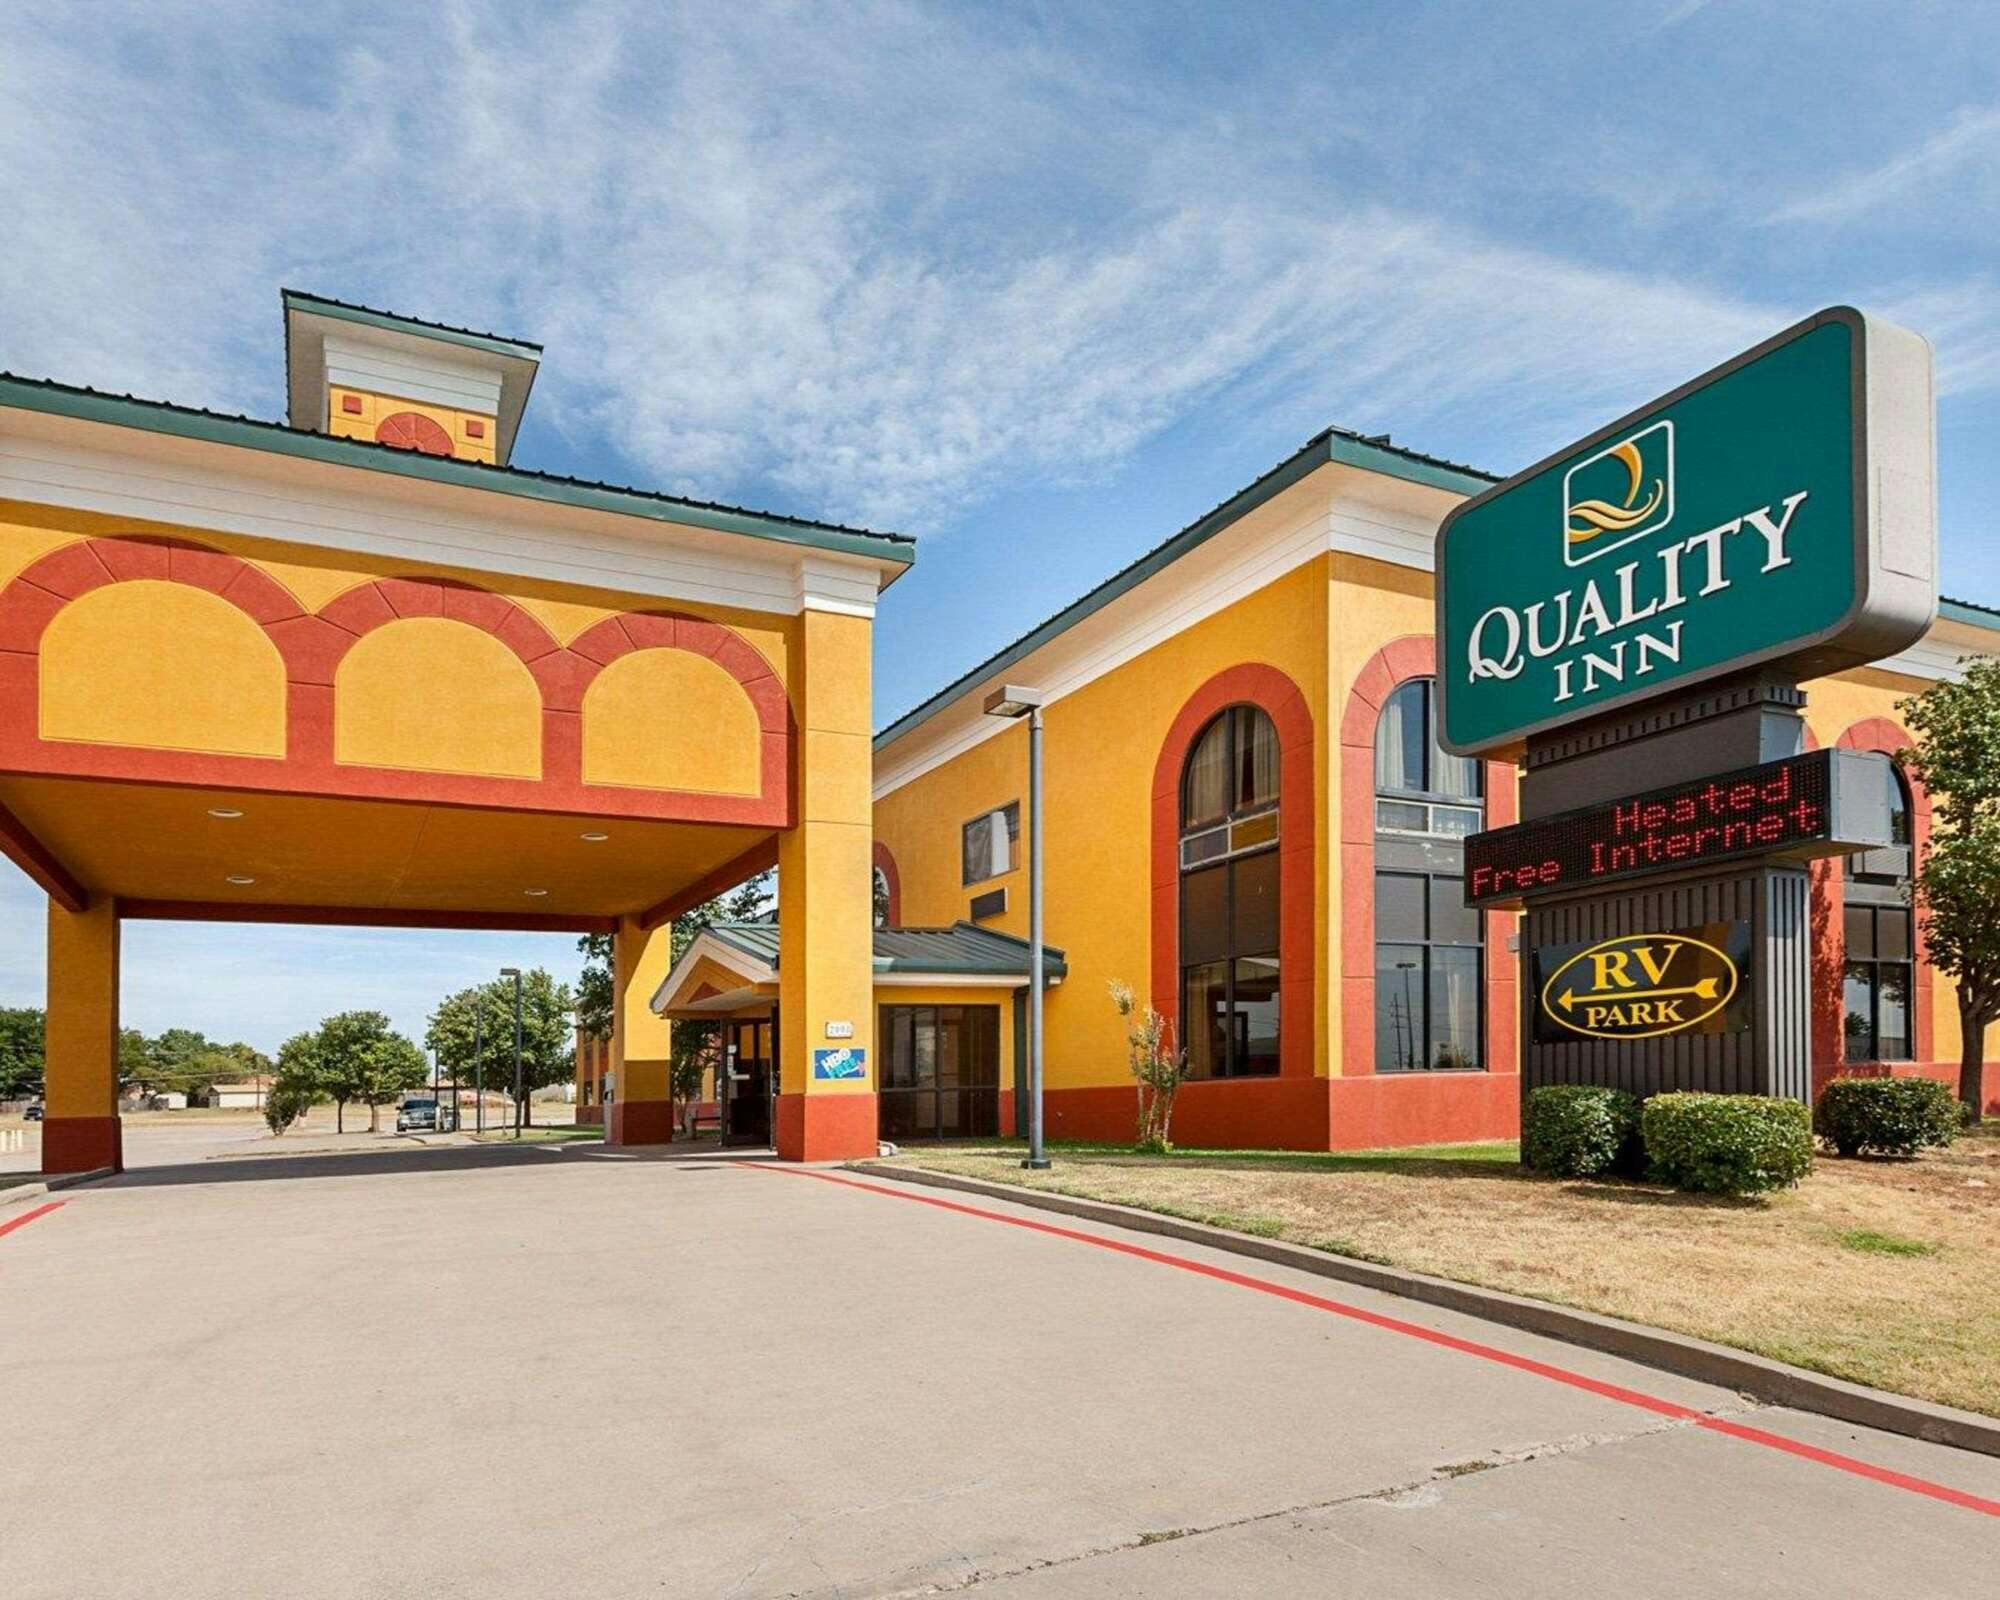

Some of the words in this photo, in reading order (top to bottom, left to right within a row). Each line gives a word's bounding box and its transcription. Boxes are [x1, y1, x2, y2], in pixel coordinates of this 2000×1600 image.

[1468, 490, 1808, 684] QUALITY
[1553, 621, 1684, 702] INN
[1614, 766, 1791, 836] Heated
[1472, 860, 1561, 897] Free
[1590, 799, 1818, 875] Internet
[1588, 943, 1683, 991] RV
[1586, 999, 1684, 1029] PARK
